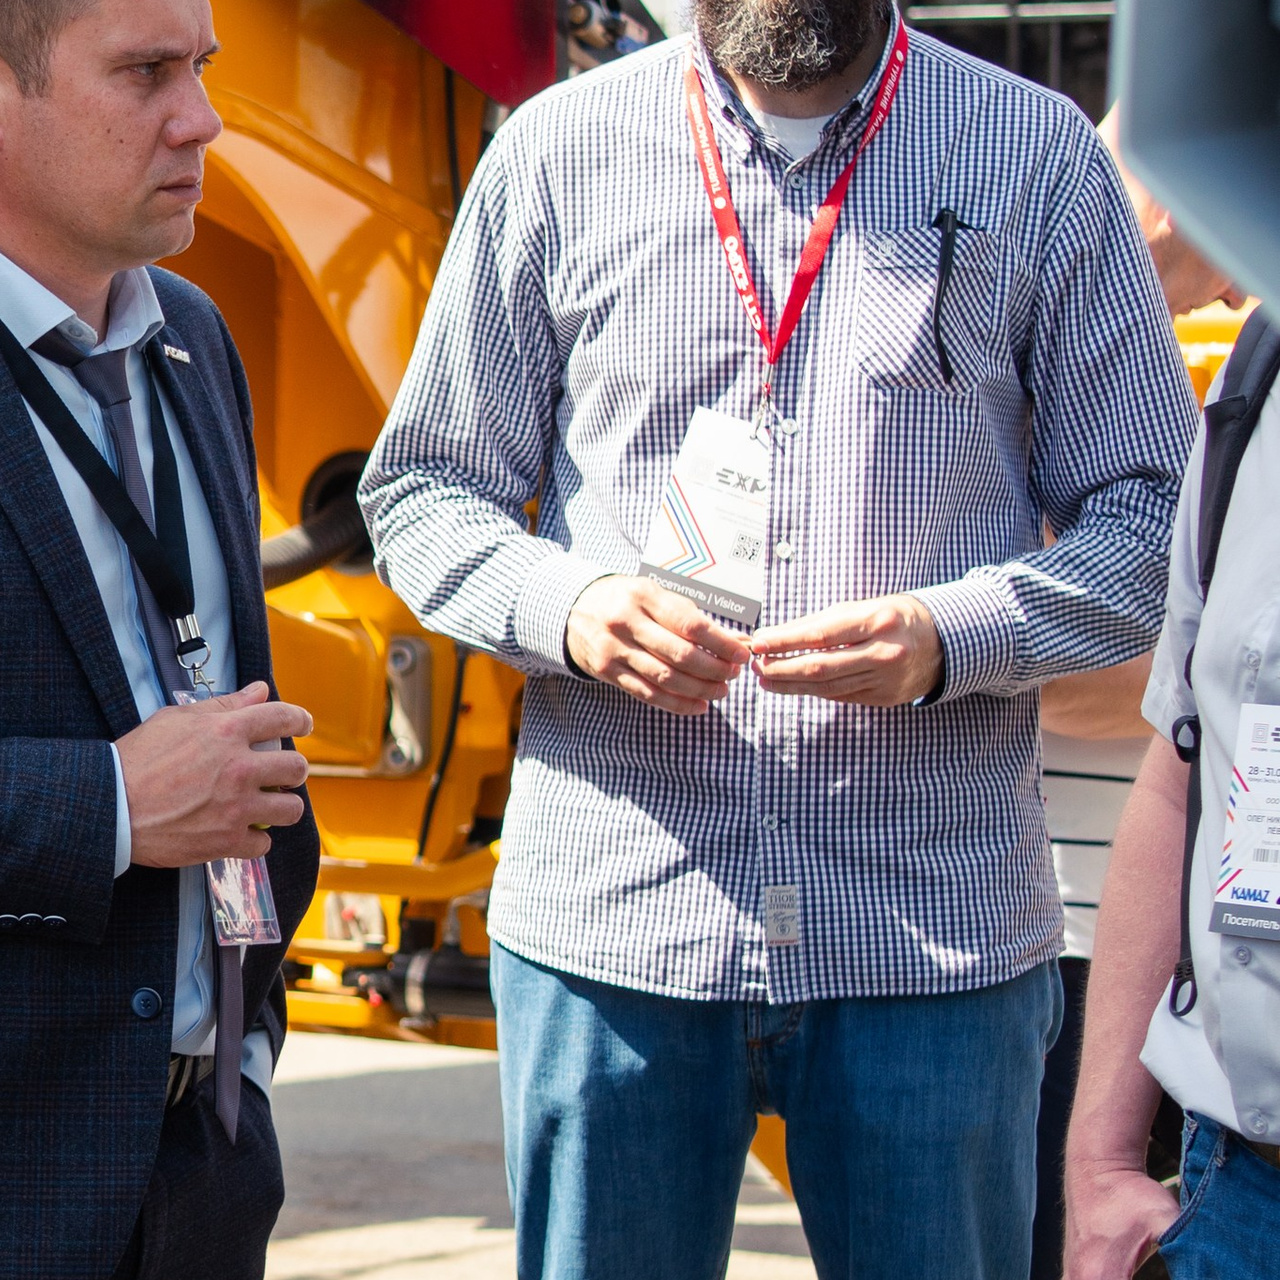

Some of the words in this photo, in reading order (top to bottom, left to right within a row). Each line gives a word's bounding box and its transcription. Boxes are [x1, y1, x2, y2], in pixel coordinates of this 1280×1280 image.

[880, 63, 900, 111] ТУРЕЦКИЕ
[702, 148, 722, 194] TURKISH
[724, 235, 749, 292] EXPO
[742, 294, 762, 331] CTT
[648, 572, 707, 602] Посетитель
[714, 594, 746, 614] Visitor
[1231, 886, 1270, 903] KAMAZ
[1222, 912, 1280, 931] Посетитель
